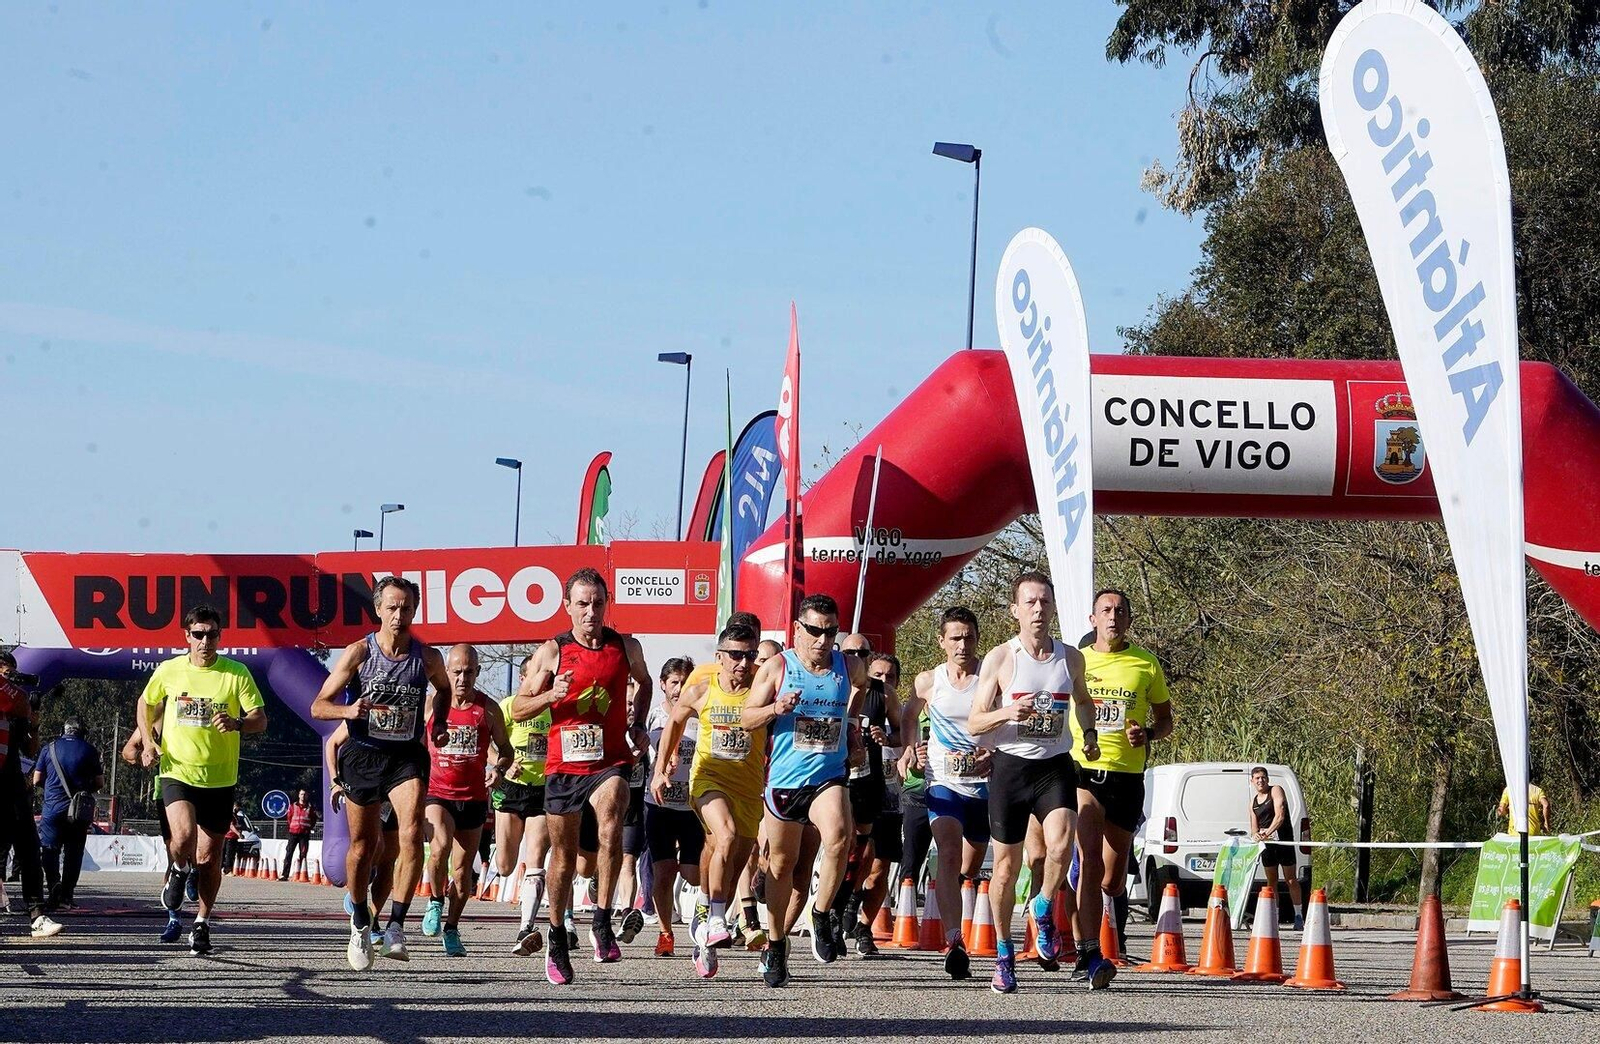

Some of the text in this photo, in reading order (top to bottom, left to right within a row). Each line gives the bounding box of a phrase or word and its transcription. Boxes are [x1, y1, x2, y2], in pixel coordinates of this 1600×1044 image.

[1103, 396, 1316, 431] CONCELLO
[1129, 438, 1291, 471] DE VIGO
[876, 547, 897, 564] de
[904, 550, 942, 567] xogo
[620, 576, 680, 586] CONCELLO
[627, 588, 673, 597] DE VIGO
[372, 683, 421, 695] castrelos
